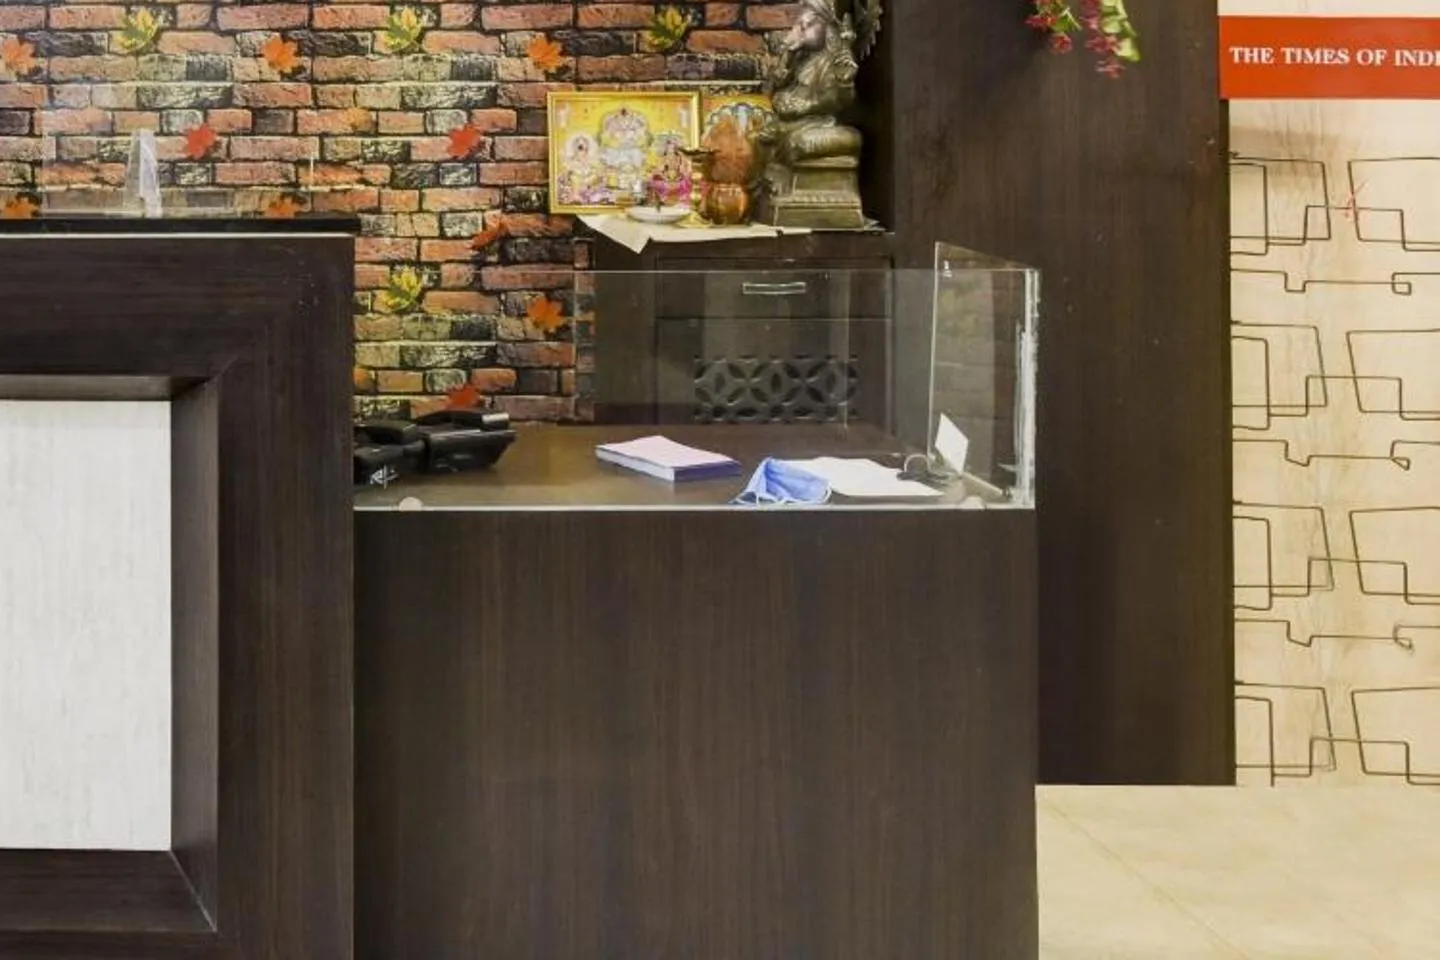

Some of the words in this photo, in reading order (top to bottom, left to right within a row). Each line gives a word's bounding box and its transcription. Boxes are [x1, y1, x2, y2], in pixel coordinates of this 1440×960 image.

[1229, 46, 1274, 65] THE
[1280, 46, 1351, 65] TIMES
[1356, 48, 1388, 66] OF
